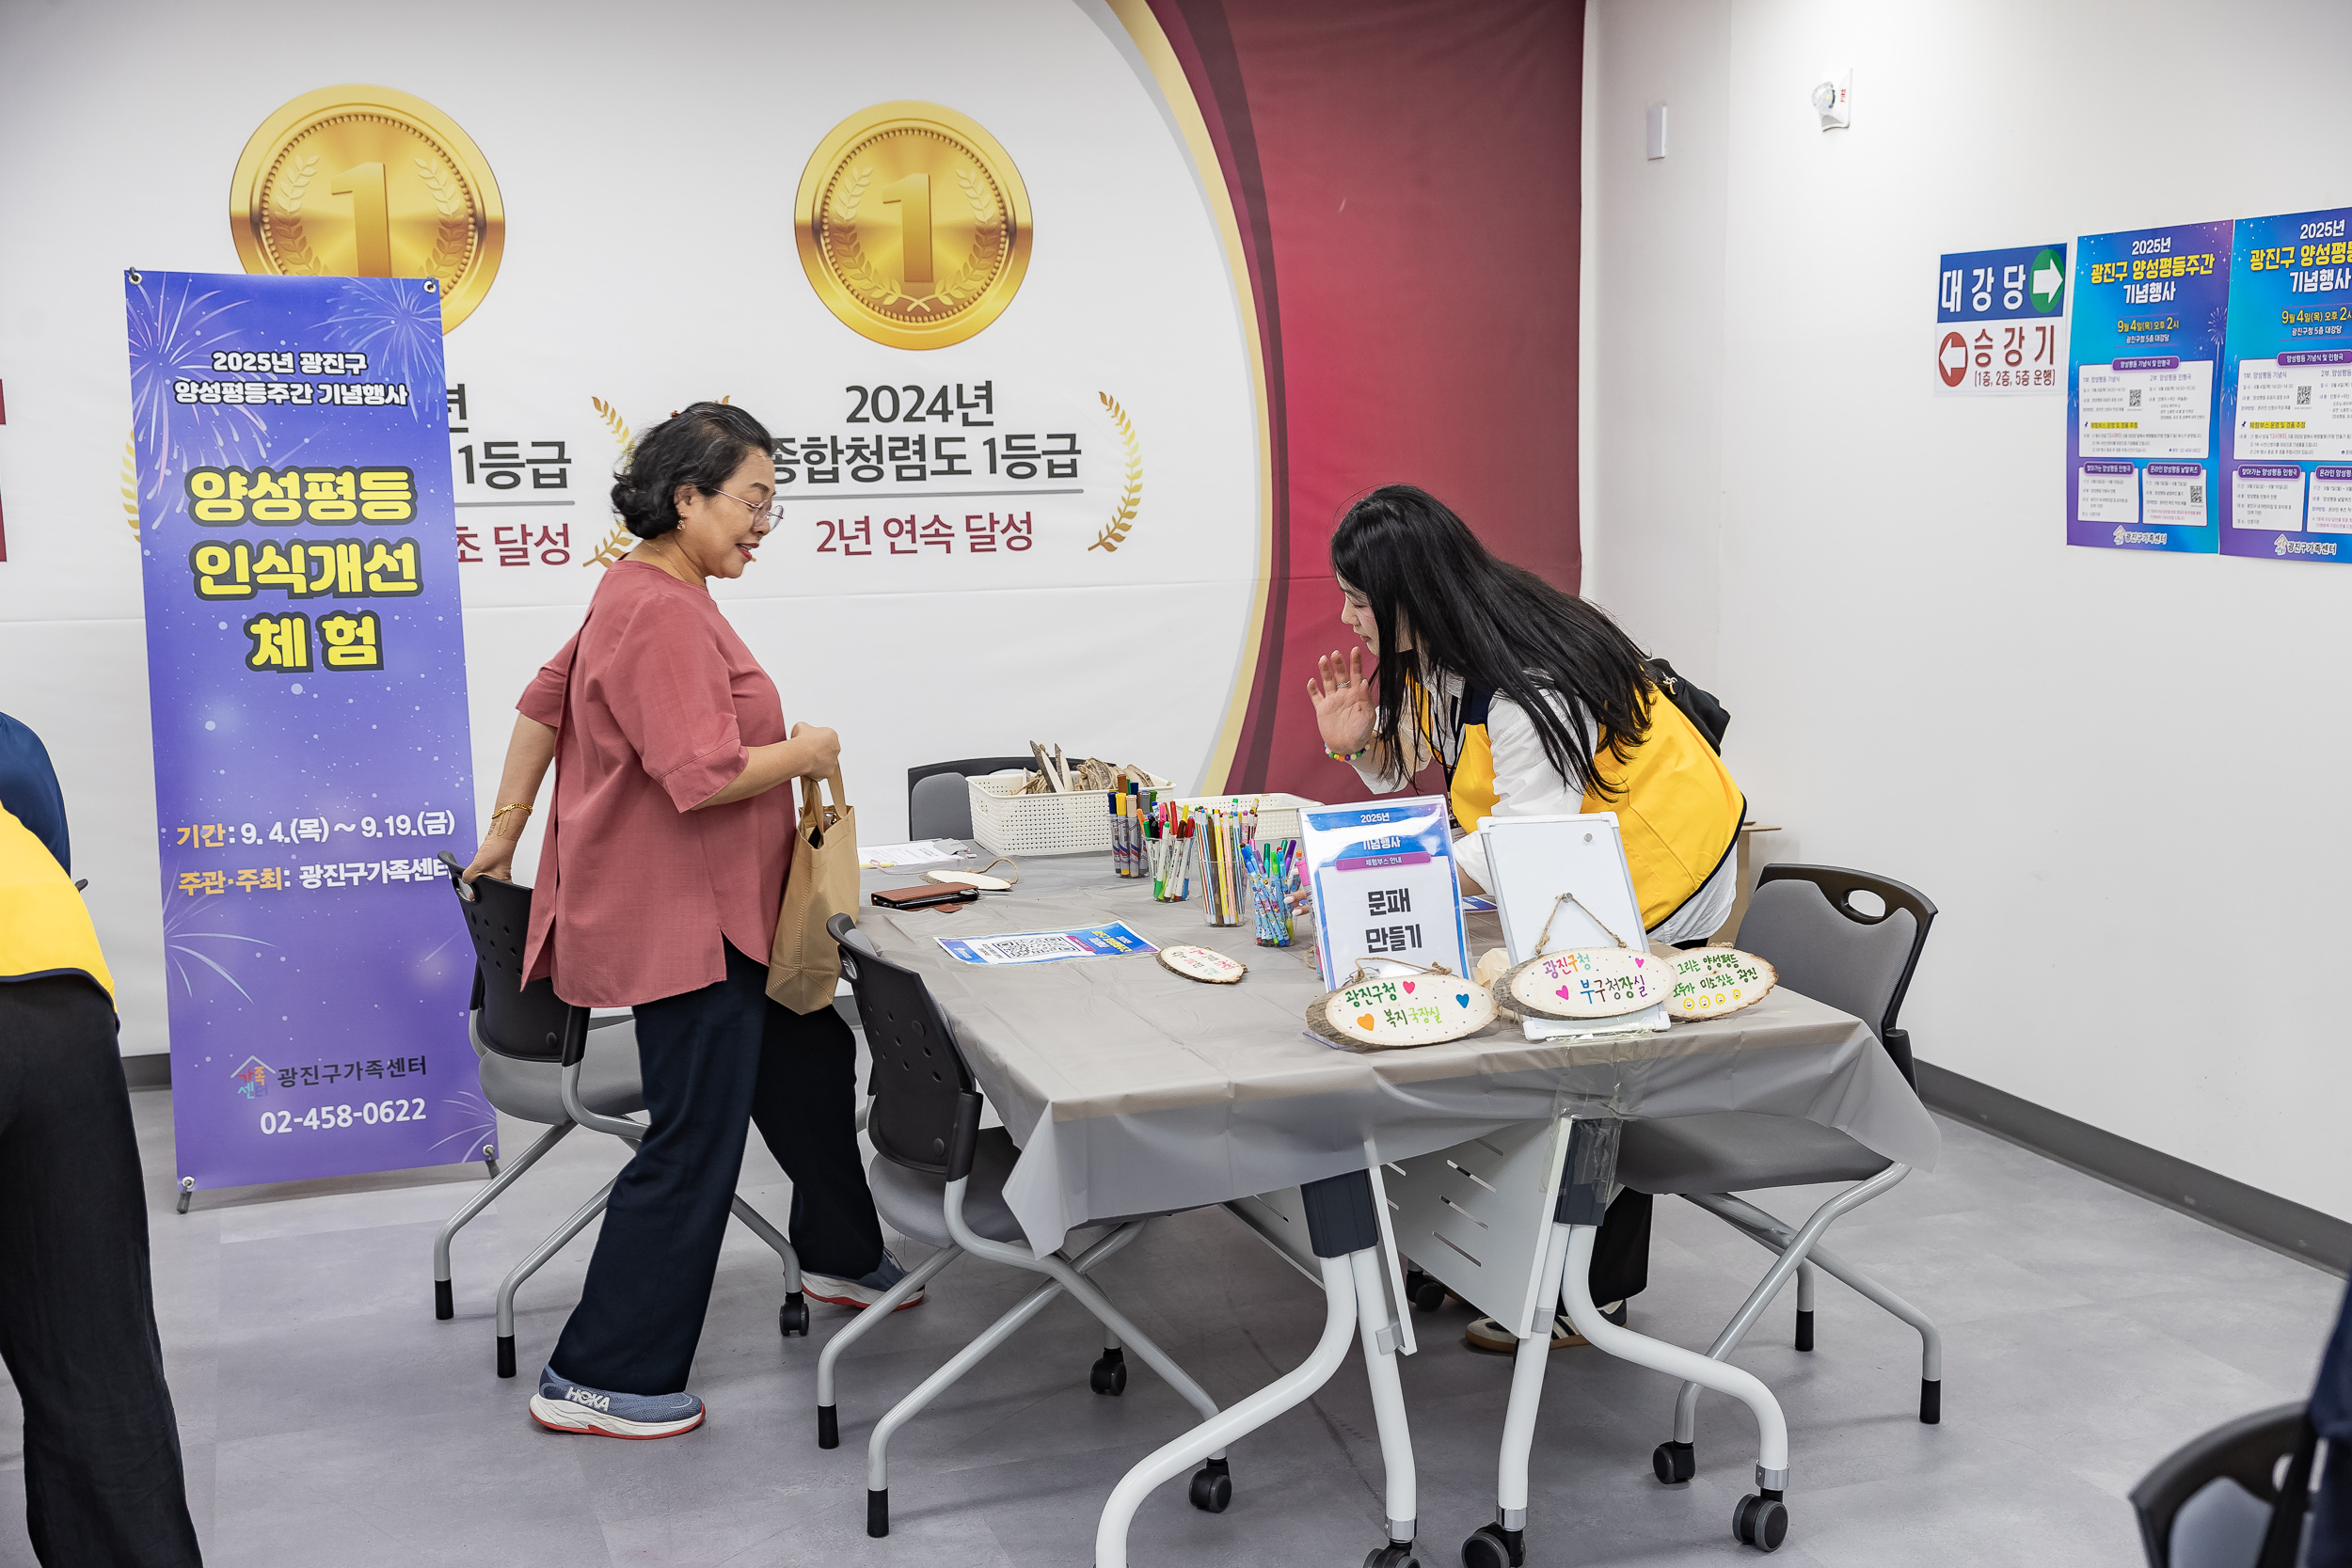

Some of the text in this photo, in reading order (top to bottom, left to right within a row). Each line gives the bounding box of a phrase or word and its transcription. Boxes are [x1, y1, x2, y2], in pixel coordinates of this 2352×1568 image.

[2300, 218, 2345, 240] 2025년
[2131, 237, 2171, 256] 2025년
[2249, 245, 2296, 271] 광진구
[2090, 253, 2216, 284] 광진구 양성평등주간
[2289, 267, 2352, 293] 기념행사
[2122, 280, 2177, 305] 기념행사
[2118, 317, 2180, 333] 9월 4일(목) 오후 2시
[2281, 310, 2296, 324] 9월
[2296, 309, 2323, 323] 4일(목)
[2325, 311, 2338, 321] 오후
[2292, 325, 2343, 337] 광진구청 5층 대강당
[1974, 325, 2055, 368] 승강기
[212, 351, 368, 374] 2025년 광진구
[1974, 369, 2056, 387] (1층, 2층, 5층 운행)
[174, 381, 408, 406] 양성평등주간 기념행사
[846, 380, 995, 427] 2024년
[458, 441, 572, 489] 1등급
[771, 433, 1082, 484] 종합청렴도 1등급
[2335, 469, 2352, 478] 양성평
[188, 468, 416, 523] 양성평등
[493, 523, 571, 567] 달성
[816, 511, 1034, 557] 2년 연속 달성
[193, 541, 421, 596] 인식개선
[360, 810, 456, 839] 9.19.(금)
[1360, 812, 1391, 824] 2025년
[1365, 855, 1402, 866] 체험부스 안내
[1368, 888, 1411, 916] 문패
[1365, 924, 1422, 954] 만들기
[1542, 952, 1591, 979] 광진구청
[1677, 954, 1740, 974] 그리는 양성평등
[1737, 967, 1758, 983] 광진
[1345, 982, 1397, 1008] 광진구청
[1580, 974, 1648, 1005] 부구청장실
[277, 1055, 427, 1088] 광진구가족센터
[260, 1097, 427, 1135] 02-458-0622
[565, 1386, 610, 1412] HOKA
